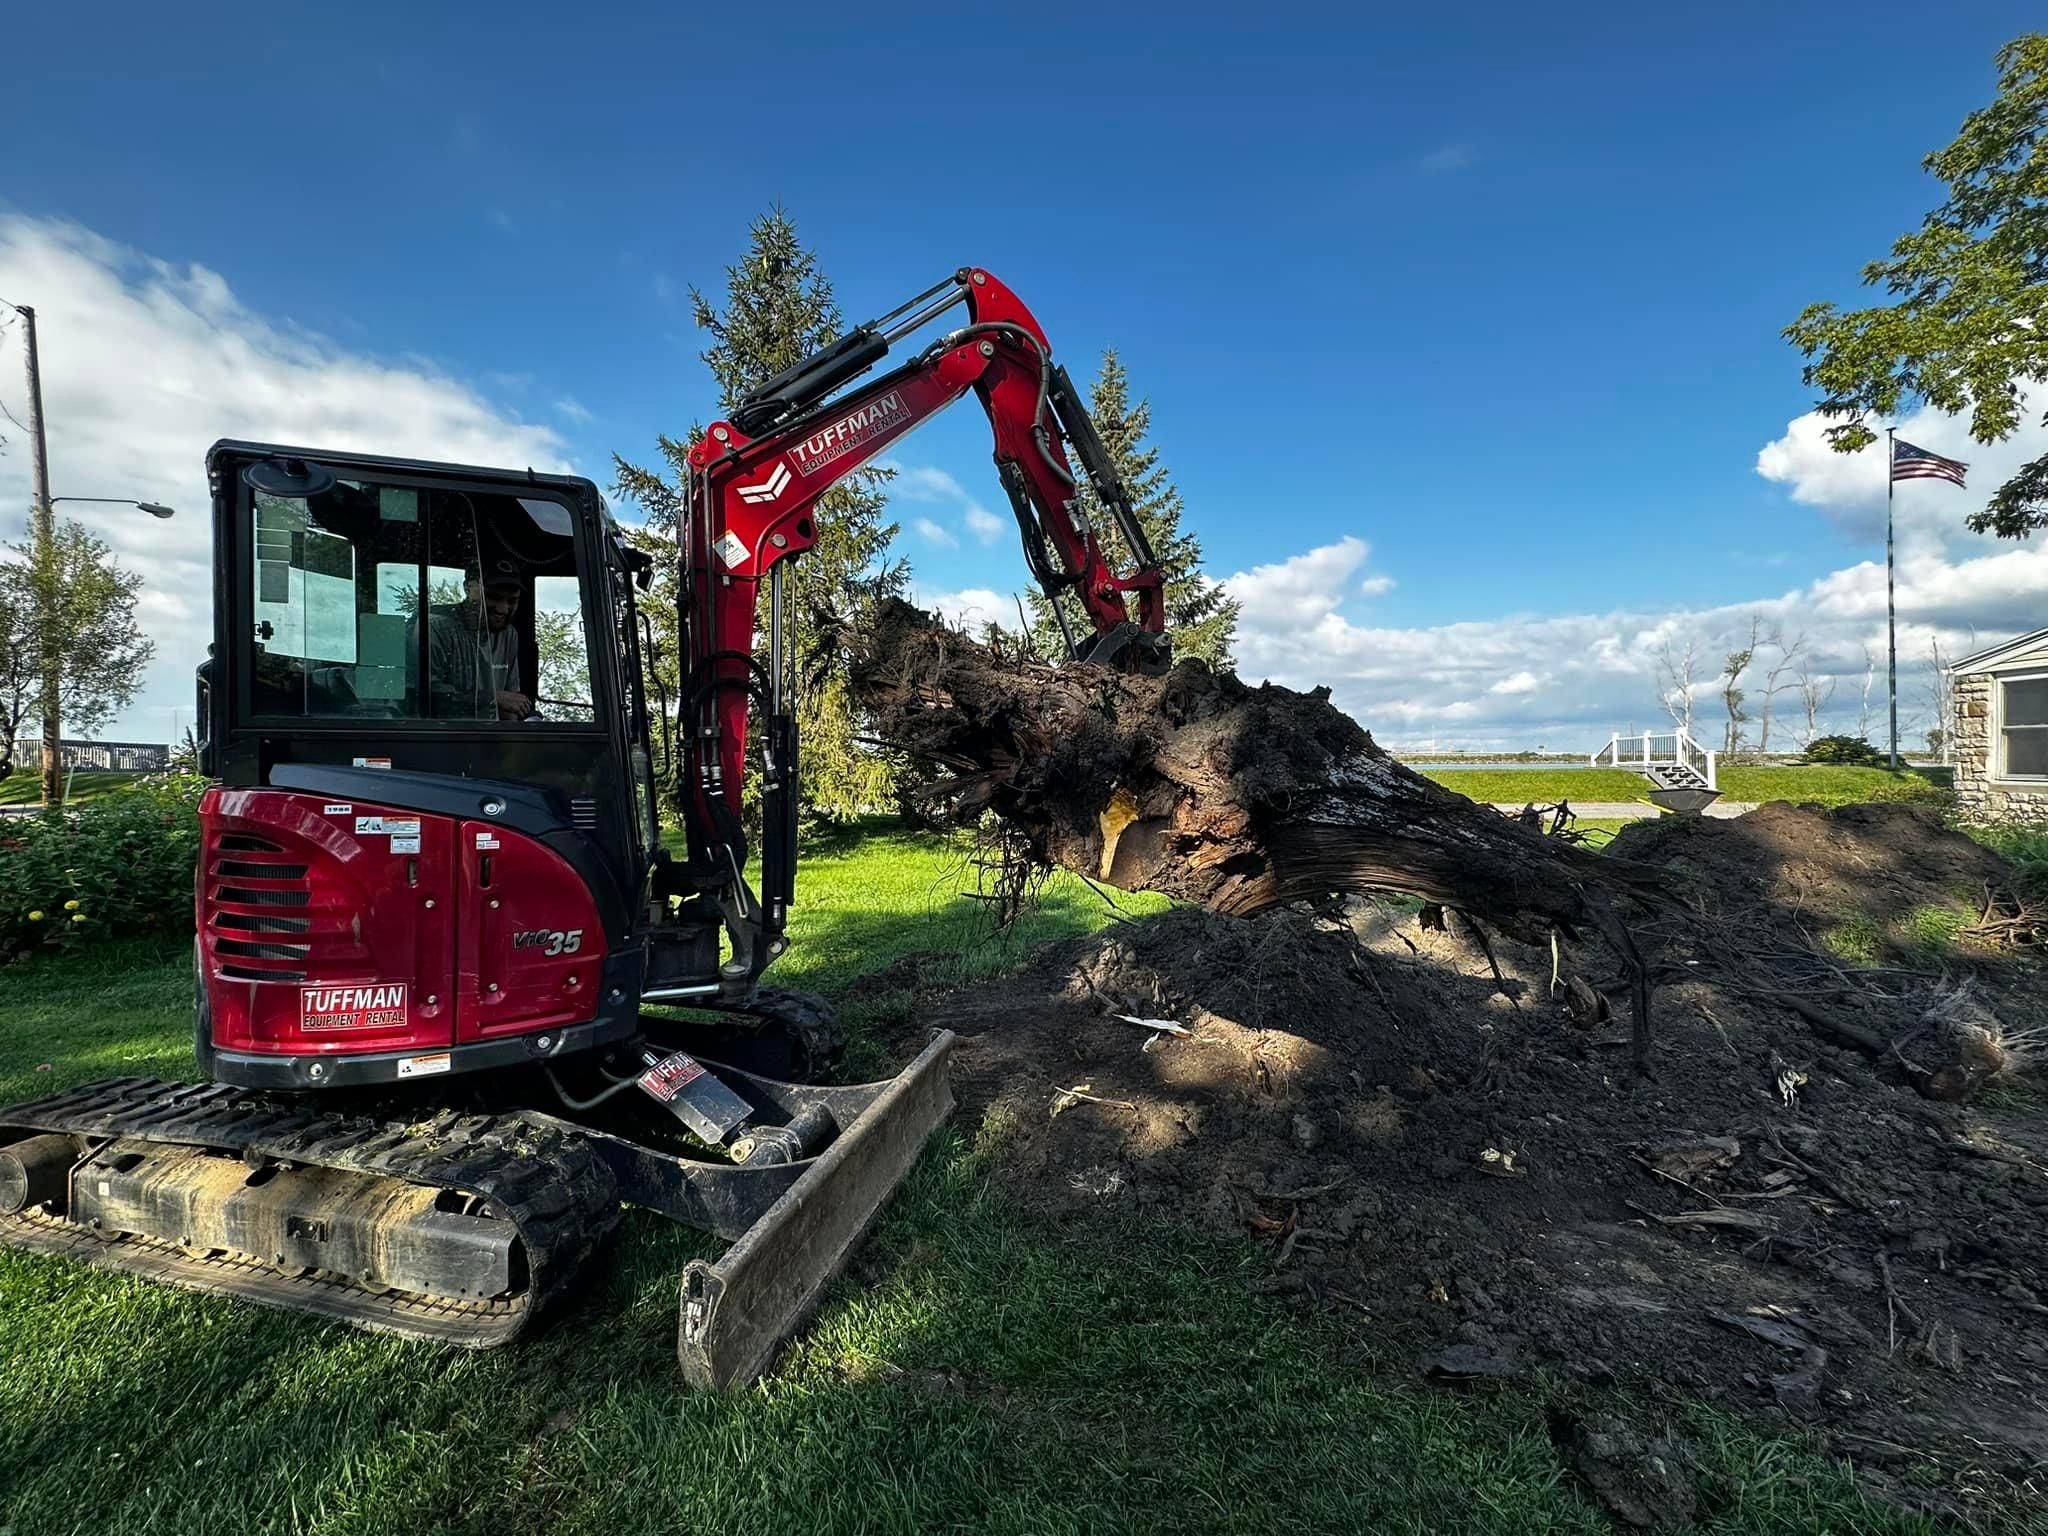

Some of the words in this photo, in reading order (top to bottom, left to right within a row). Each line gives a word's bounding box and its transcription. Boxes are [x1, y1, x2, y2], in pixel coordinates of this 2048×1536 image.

[793, 394, 898, 462] TUFFMAN
[803, 434, 863, 473] EQUIPMENT
[868, 410, 908, 436] RENTAL
[304, 986, 403, 1012] TUFFMAN
[304, 1013, 360, 1027] EQUIPMENT
[366, 1011, 405, 1025] RENTAL
[644, 1054, 694, 1089] TUFFMA
